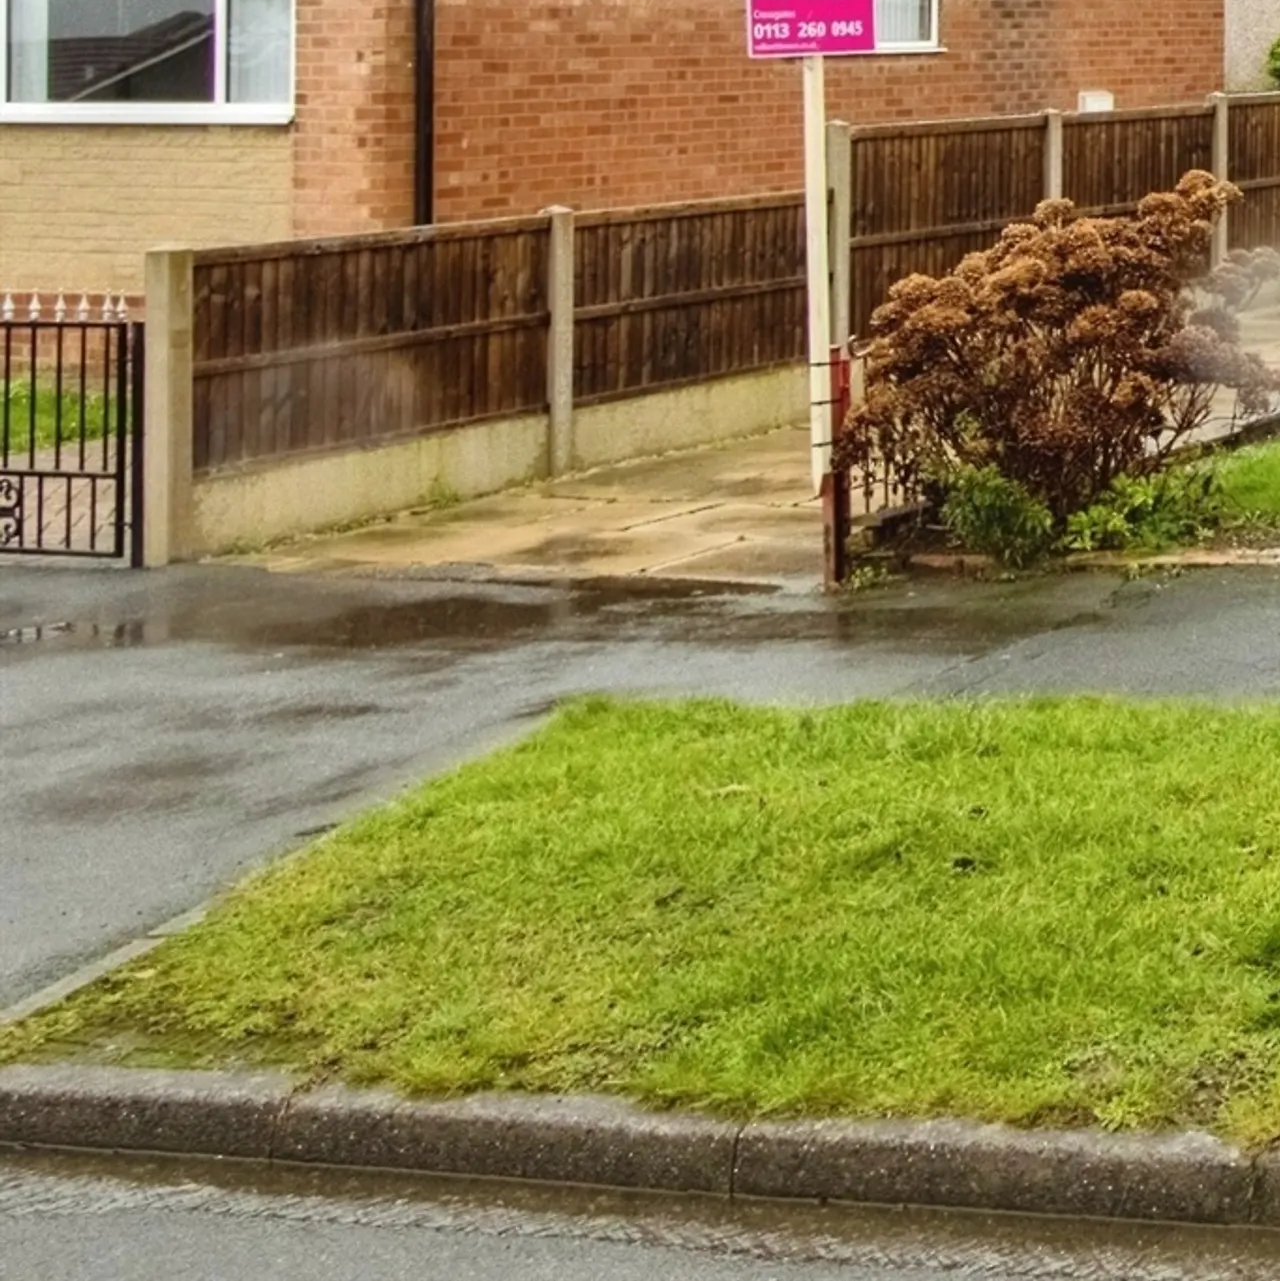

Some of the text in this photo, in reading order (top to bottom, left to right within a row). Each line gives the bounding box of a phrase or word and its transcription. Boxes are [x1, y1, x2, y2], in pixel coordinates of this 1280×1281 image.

[753, 20, 863, 39] 0113 260 0945
